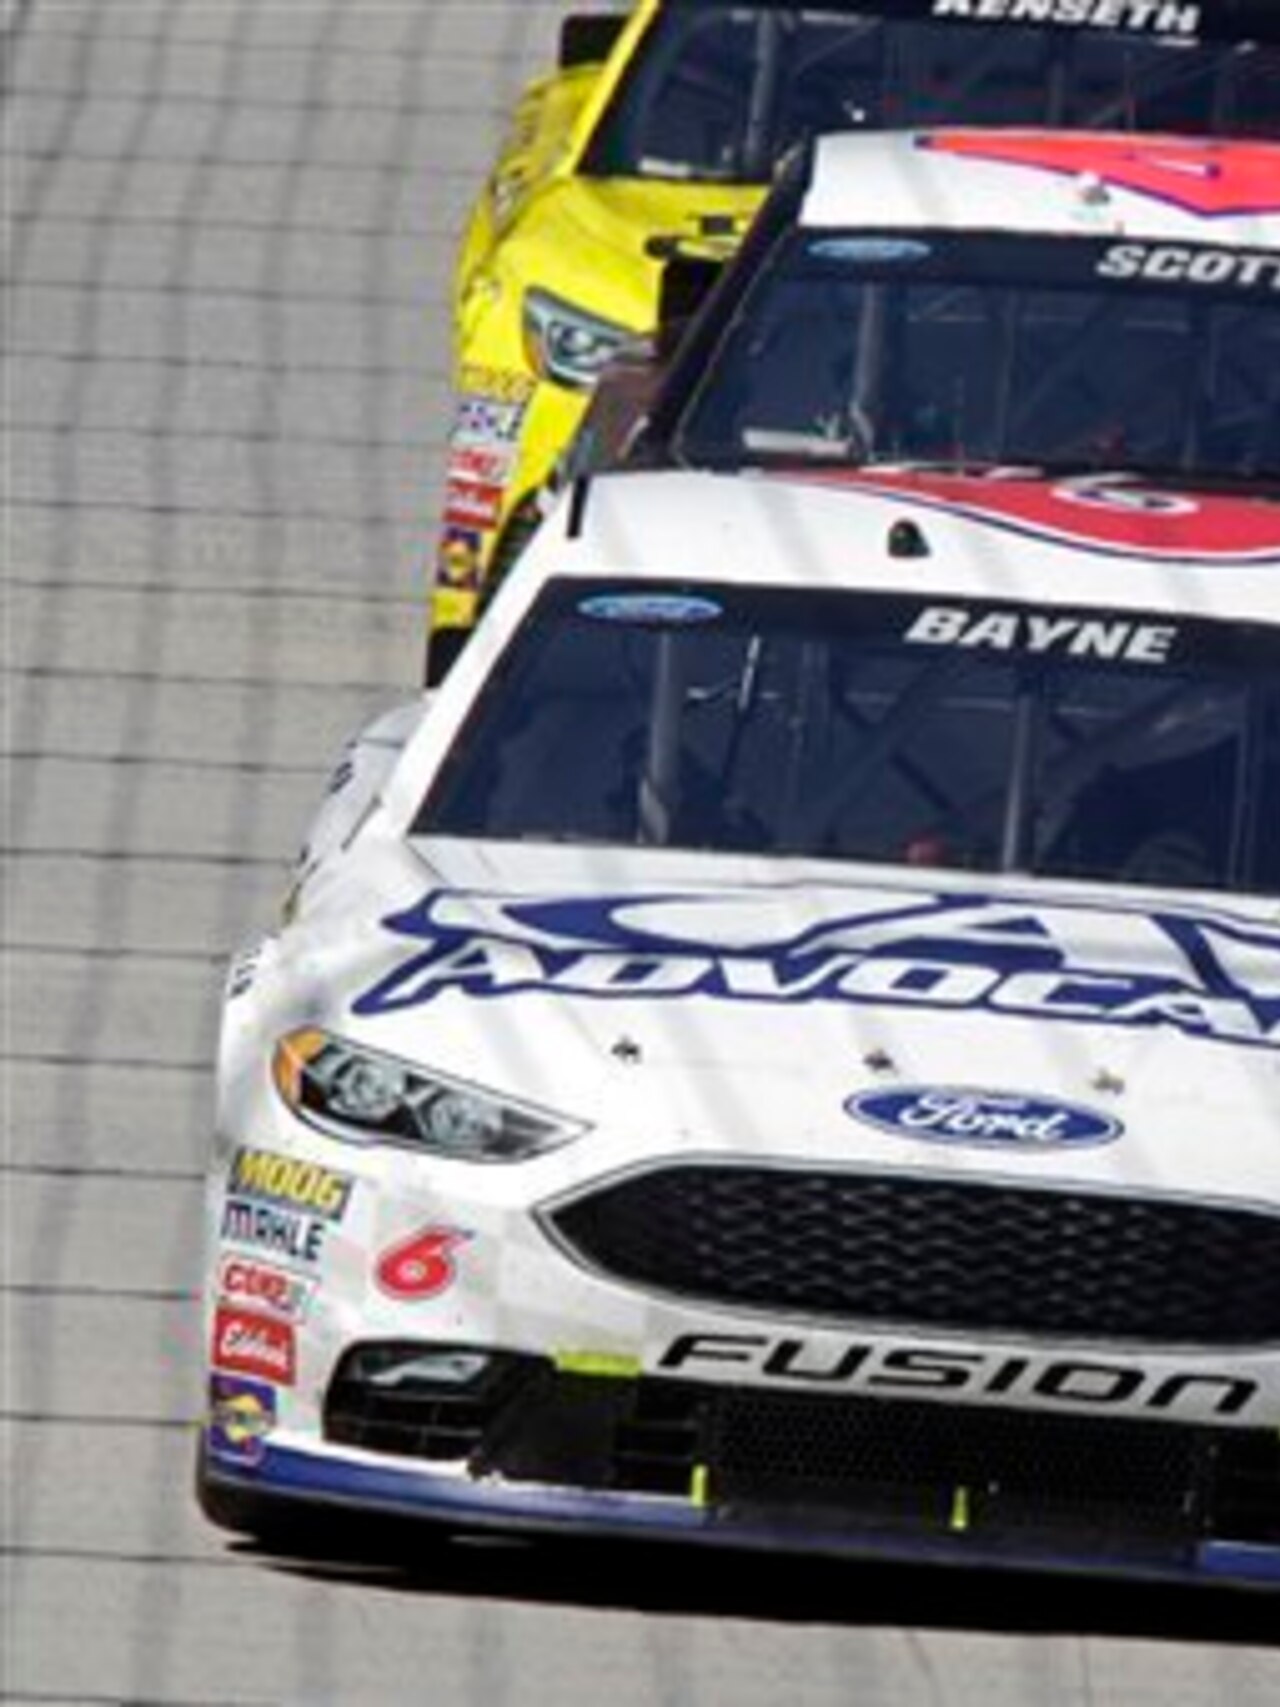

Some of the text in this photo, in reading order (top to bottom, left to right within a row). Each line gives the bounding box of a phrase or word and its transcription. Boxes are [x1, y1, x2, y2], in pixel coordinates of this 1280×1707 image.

[906, 606, 1177, 664] BAYNE
[900, 1091, 1070, 1141] Ford
[237, 1150, 347, 1218] MOOG
[220, 1199, 323, 1262] MAHLE
[374, 1224, 472, 1300] 6
[658, 1333, 1260, 1416] FUSION
